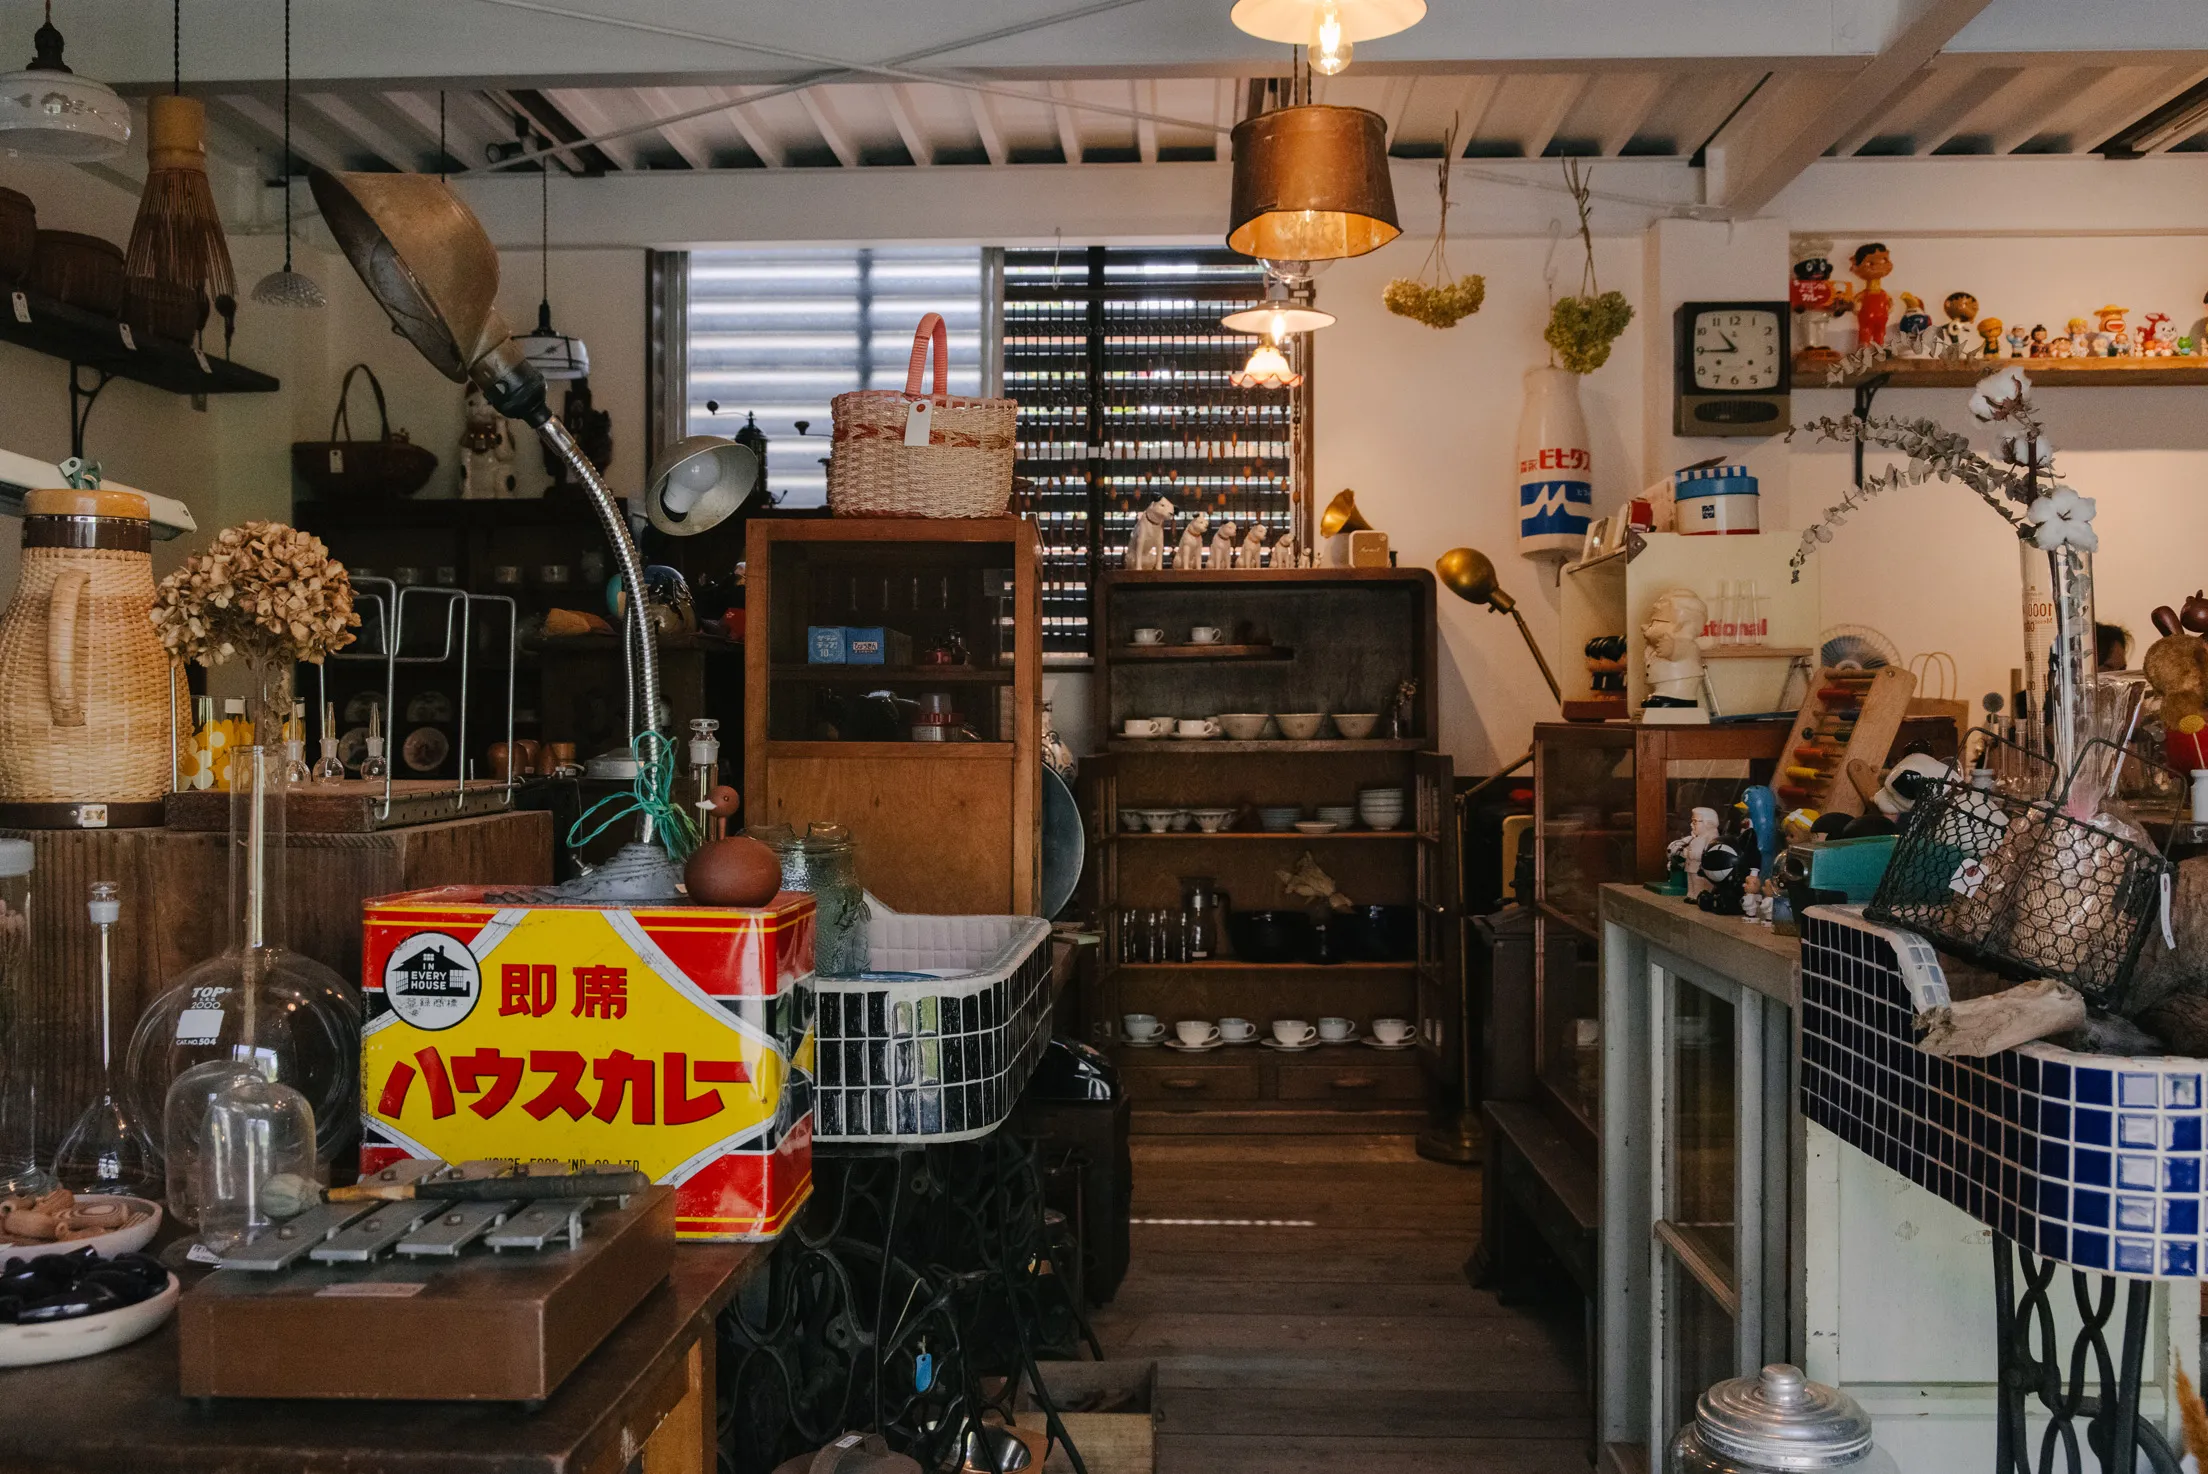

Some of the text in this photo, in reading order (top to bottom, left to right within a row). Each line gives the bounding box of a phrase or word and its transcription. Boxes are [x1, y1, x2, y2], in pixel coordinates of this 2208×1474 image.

[1712, 317, 1721, 326] 11
[1729, 316, 1741, 326] 12
[1752, 317, 1756, 326] 1
[1697, 327, 1706, 336] 10
[1764, 326, 1773, 336] 2
[1696, 346, 1704, 355] 9
[1767, 345, 1773, 355] 3
[1697, 366, 1706, 375] 8
[1764, 366, 1772, 374] 4
[1712, 375, 1720, 384] 7
[1730, 376, 1739, 385] 6
[1749, 375, 1758, 384] 5
[1699, 618, 1767, 637] ational
[422, 962, 435, 971] IN
[410, 971, 447, 980] EVERY
[410, 981, 447, 990] HOUSE
[498, 964, 628, 1020] 即席
[377, 1045, 752, 1126] ハウスカレー
